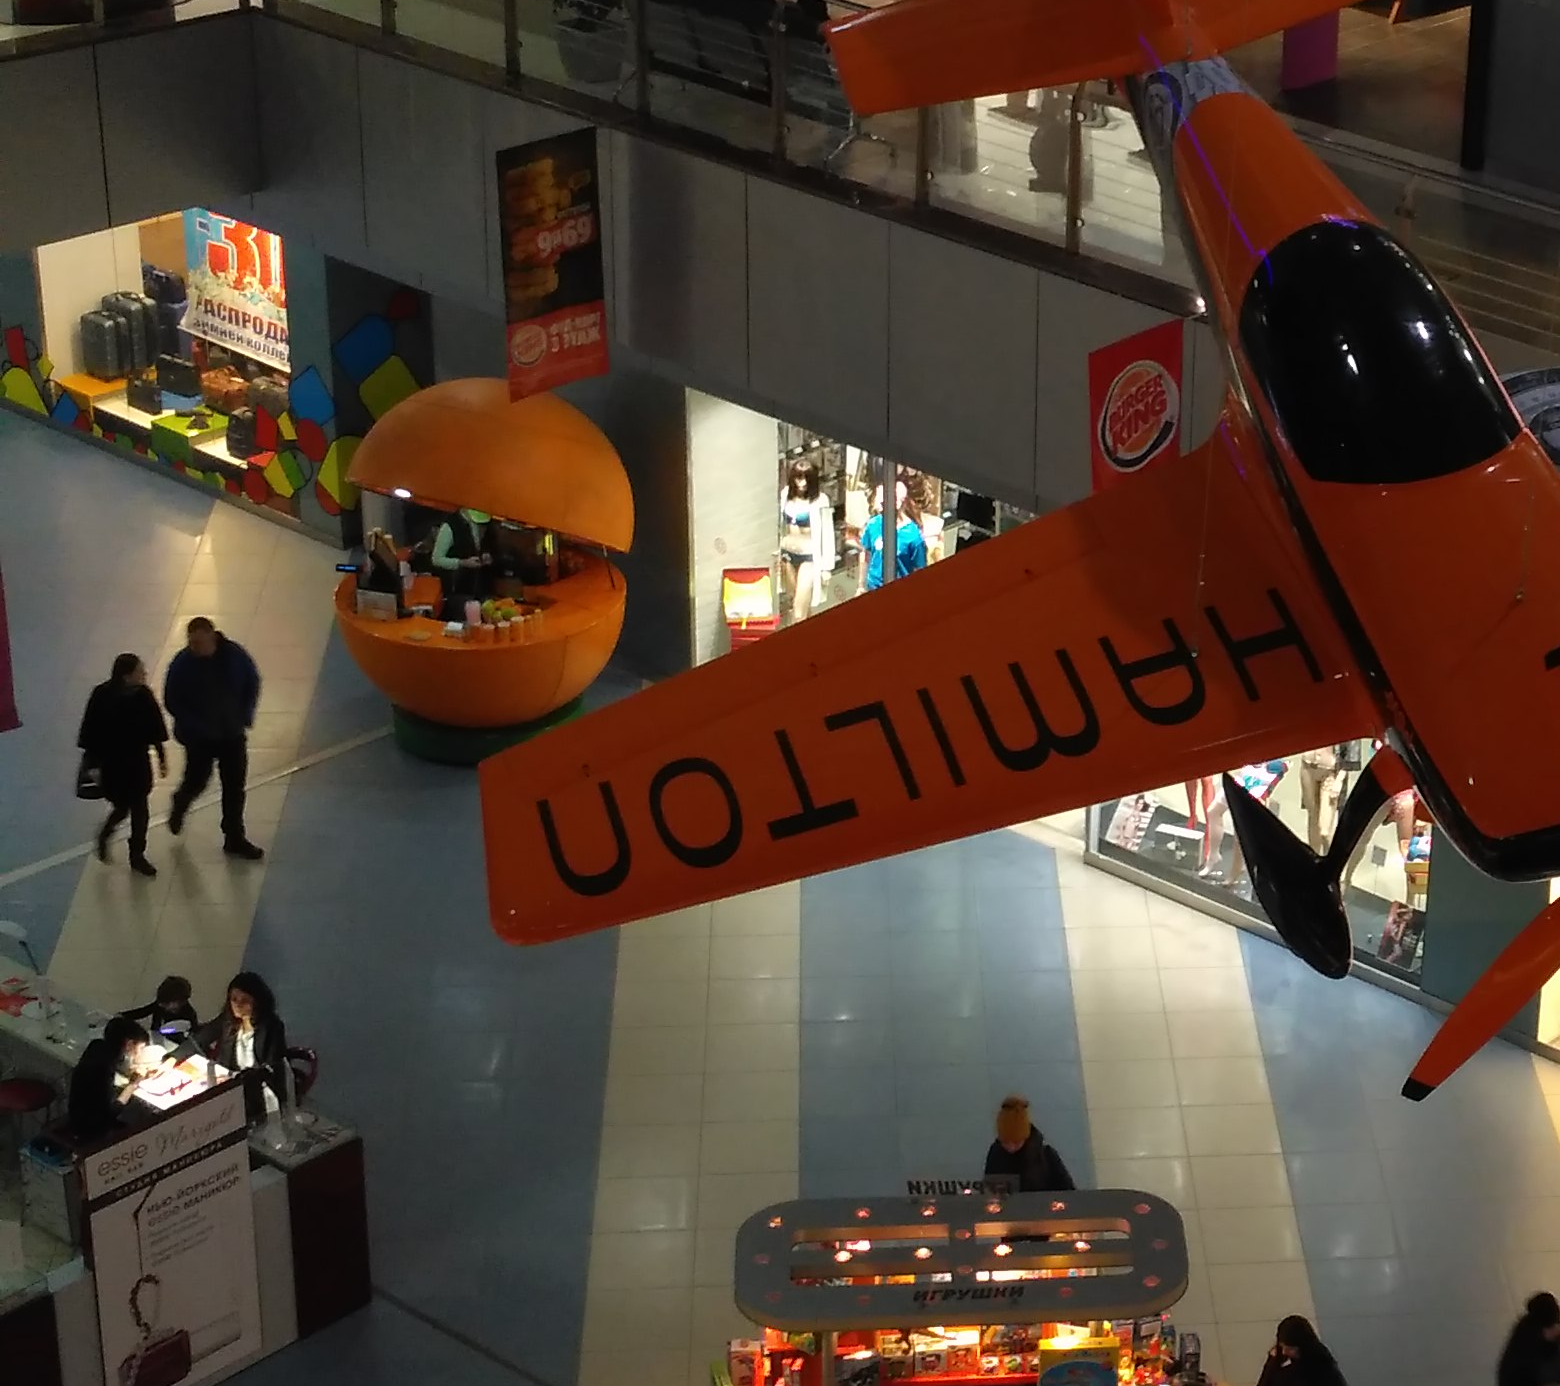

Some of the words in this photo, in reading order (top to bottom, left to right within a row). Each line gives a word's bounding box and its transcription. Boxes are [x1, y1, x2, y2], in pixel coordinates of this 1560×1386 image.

[1109, 373, 1164, 431] BURGER
[1110, 389, 1168, 456] KING
[536, 587, 1325, 898] HAMILTON
[97, 1143, 148, 1177] essie
[913, 1285, 1025, 1302] ИГРУШКИ
